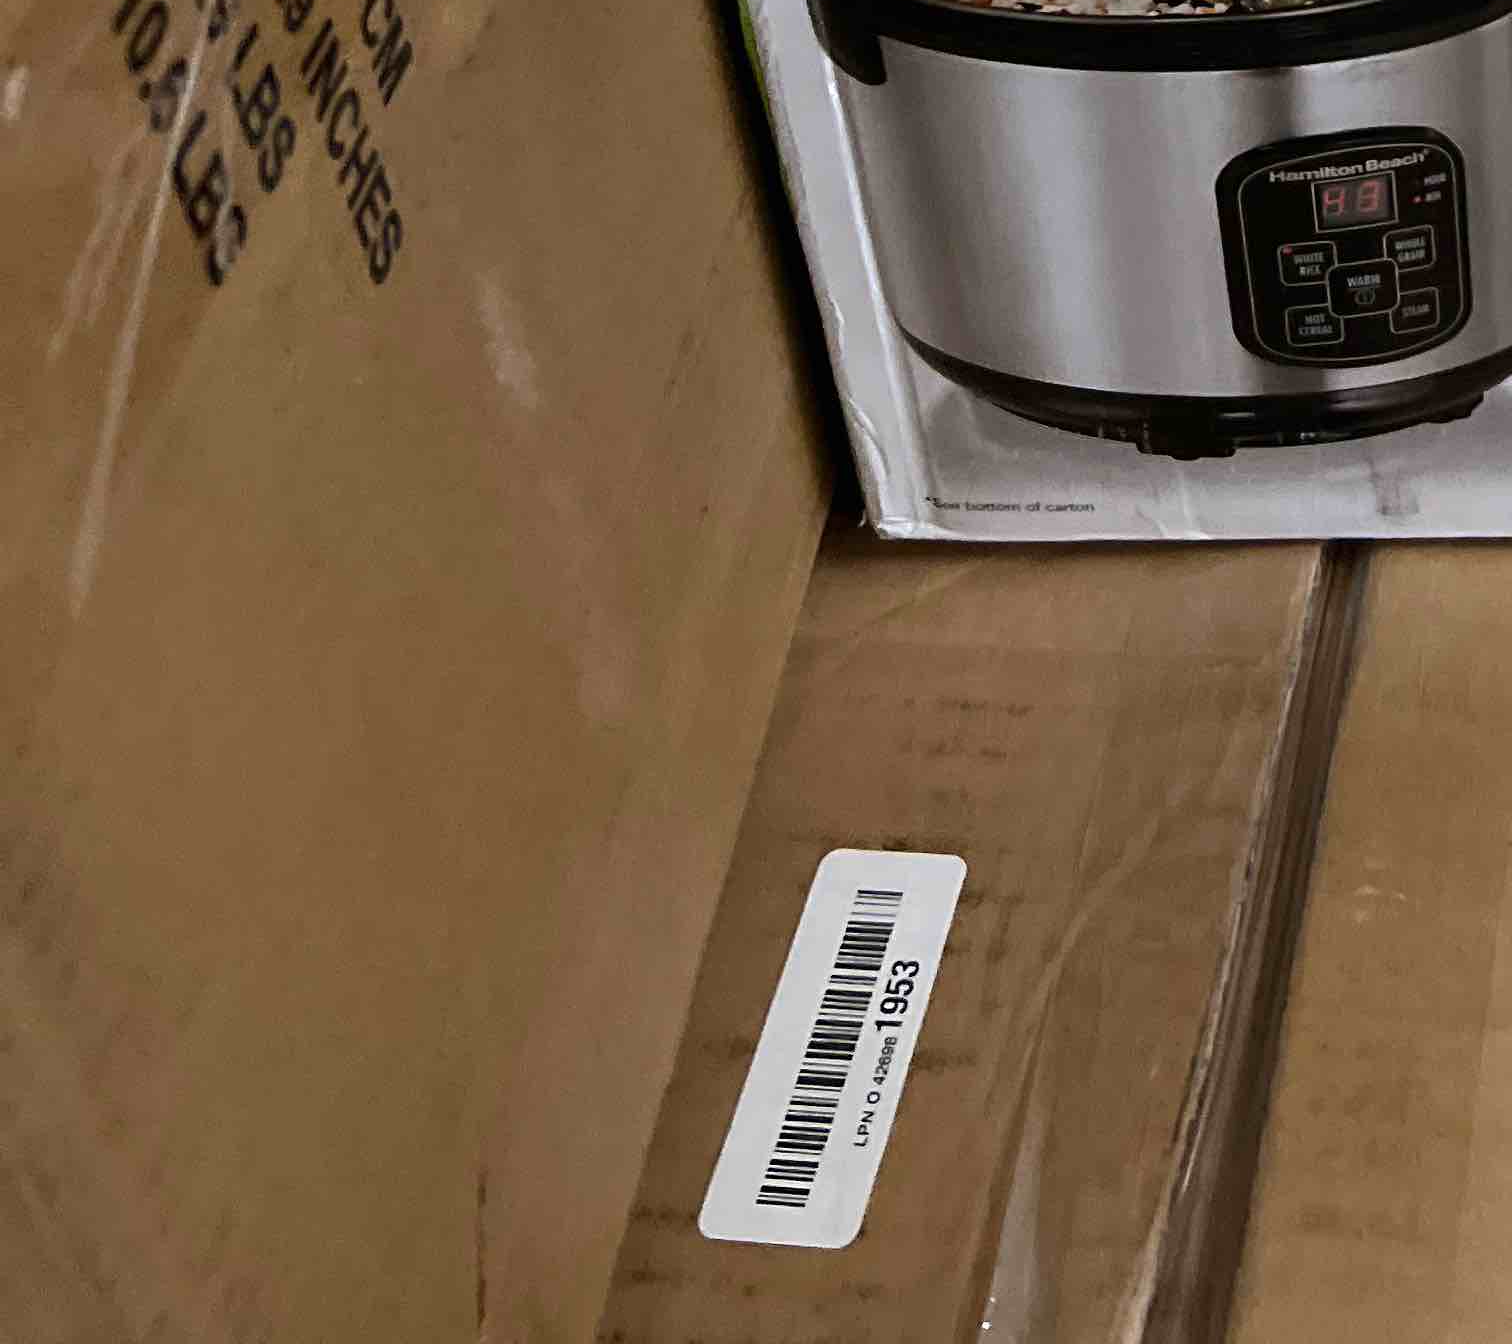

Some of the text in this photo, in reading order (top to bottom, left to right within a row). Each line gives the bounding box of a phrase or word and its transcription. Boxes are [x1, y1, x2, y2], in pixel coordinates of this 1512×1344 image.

[230, 23, 297, 193] LBS
[301, 19, 403, 285] INCHES
[1269, 152, 1424, 182] Hamilton Beach
[966, 502, 1020, 512] bottom
[1025, 502, 1040, 512] of
[1045, 503, 1095, 513] carton
[853, 1111, 875, 1148] LPN
[875, 960, 920, 1032] 1953
